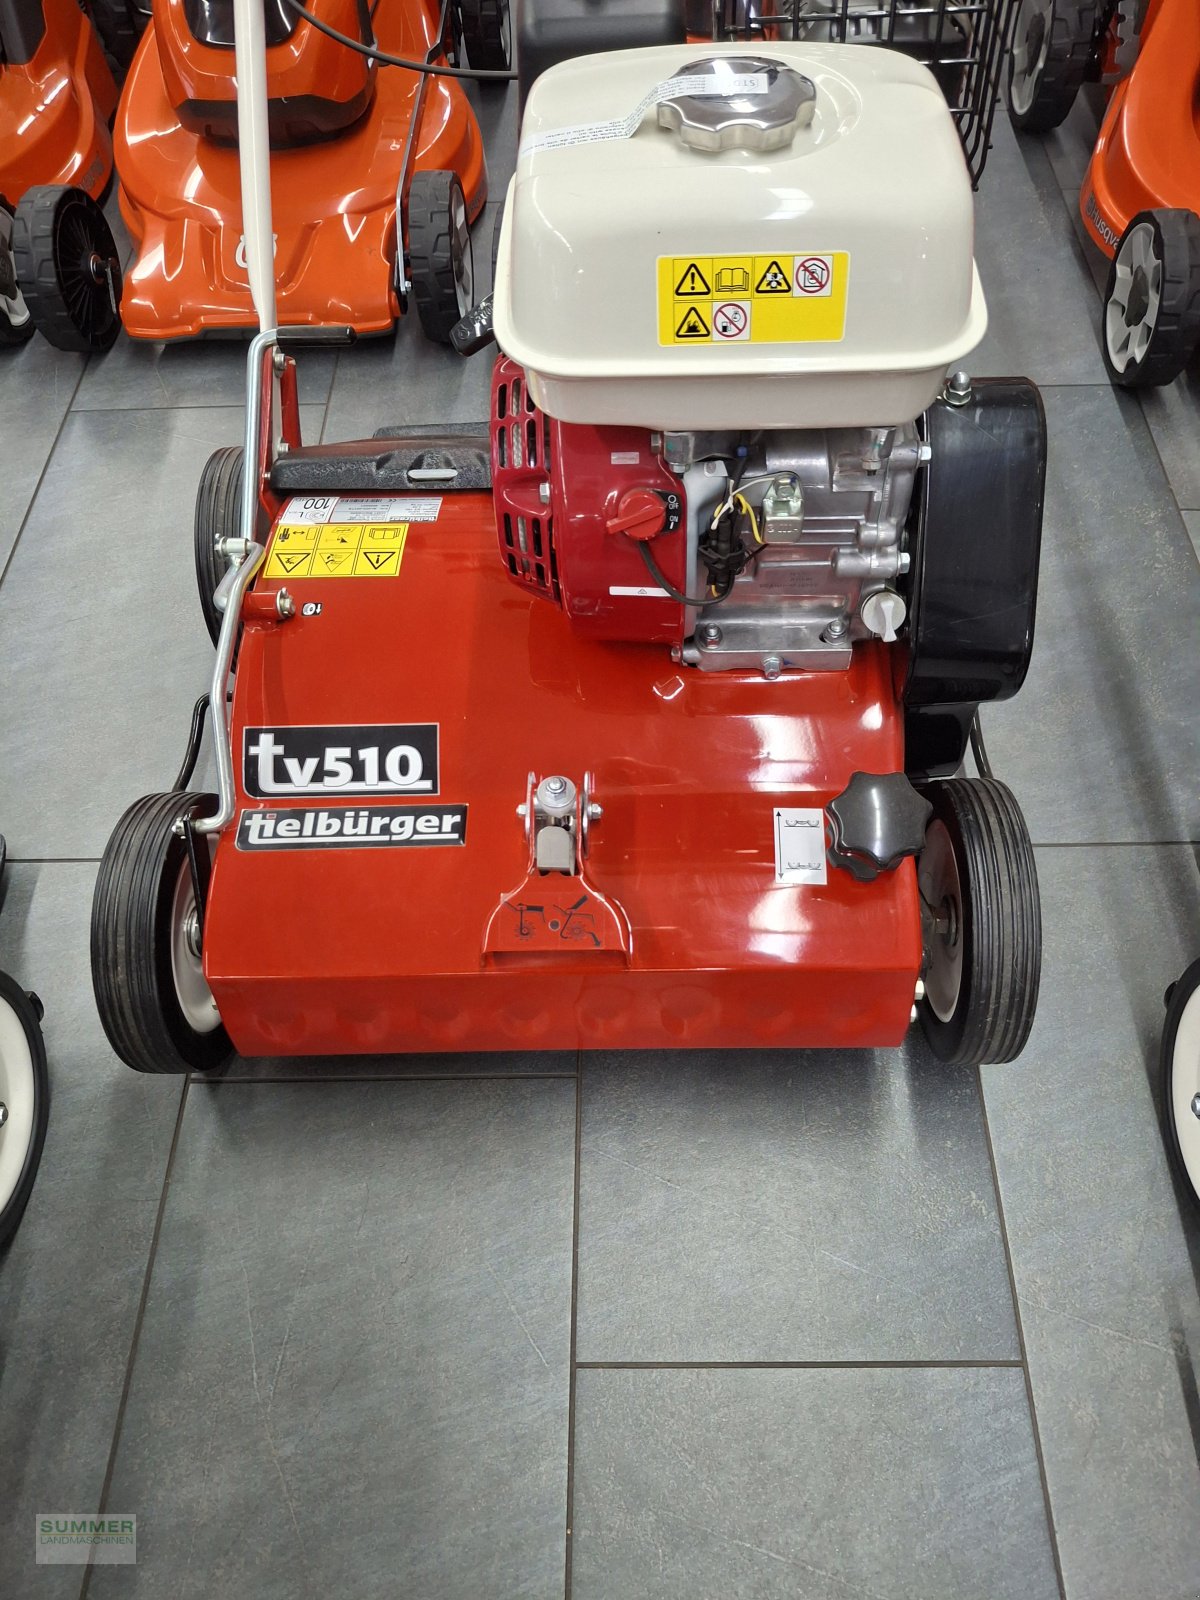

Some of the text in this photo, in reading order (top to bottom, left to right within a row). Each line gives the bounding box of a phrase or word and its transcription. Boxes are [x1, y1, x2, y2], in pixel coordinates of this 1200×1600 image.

[303, 498, 330, 509] 100
[248, 732, 433, 794] tv510
[244, 810, 461, 845] tielbürger
